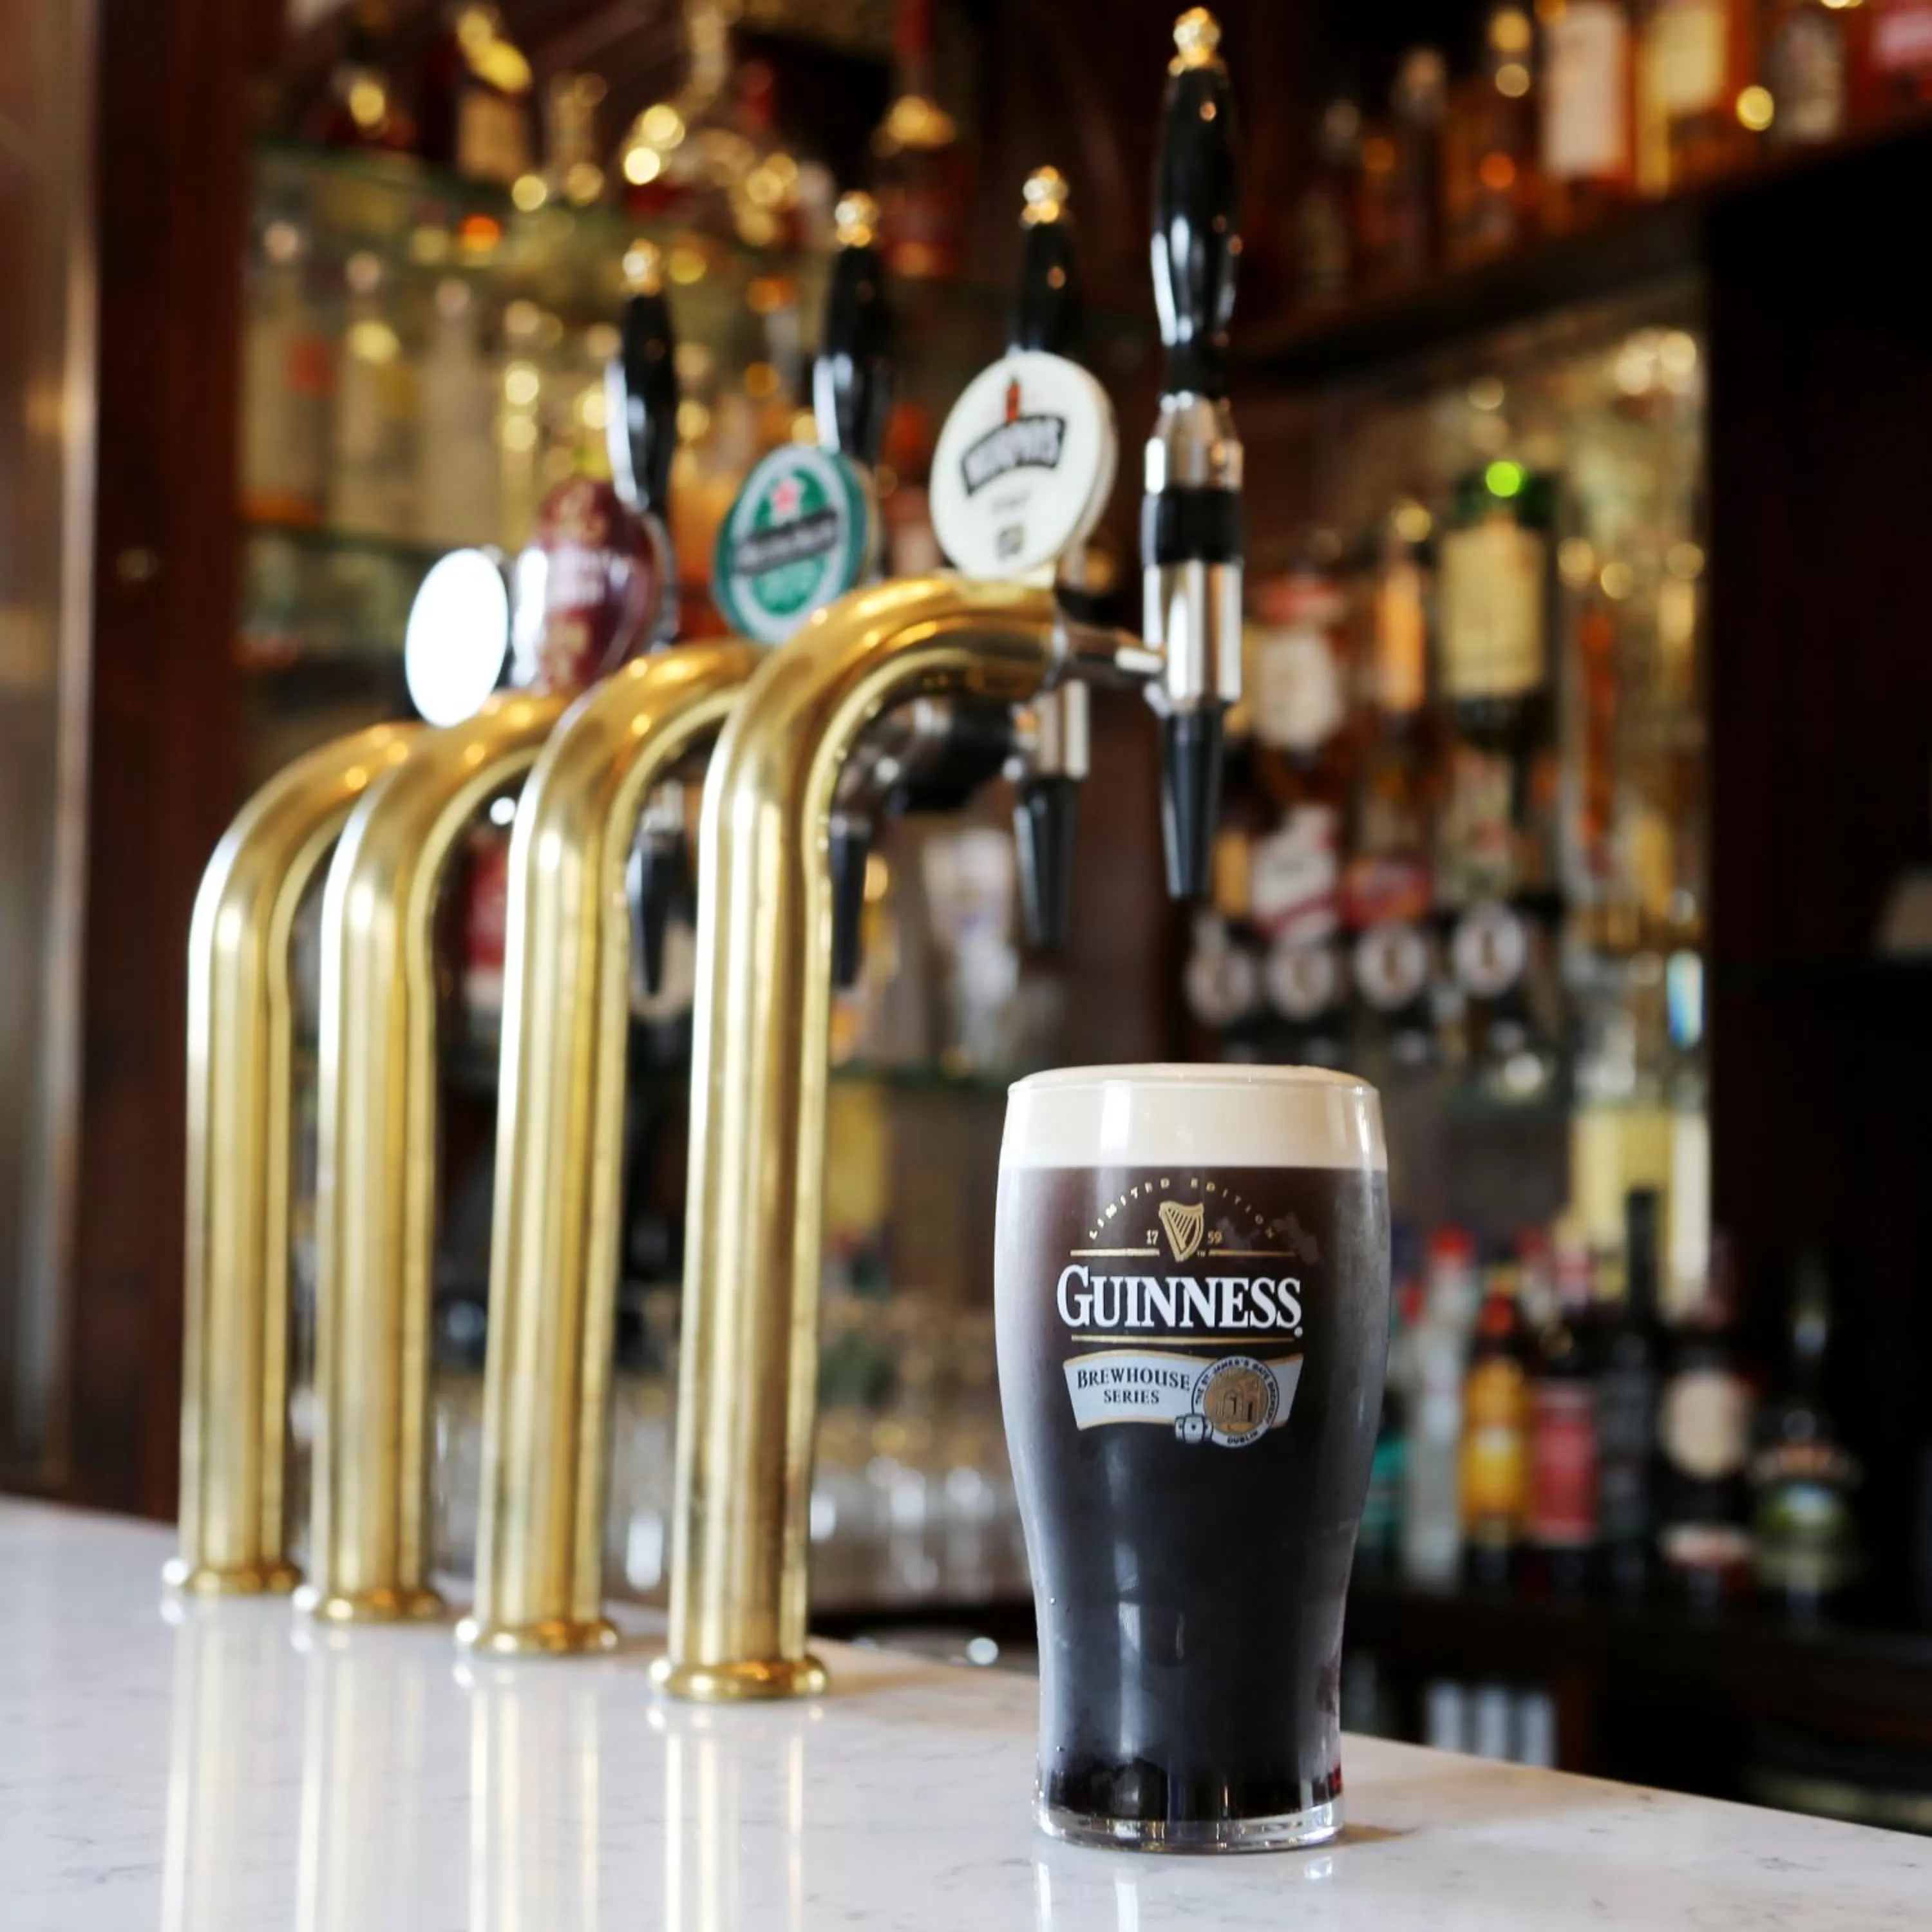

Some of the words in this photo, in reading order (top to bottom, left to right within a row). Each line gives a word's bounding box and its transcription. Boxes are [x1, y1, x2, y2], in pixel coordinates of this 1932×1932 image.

[1191, 1177, 1275, 1239] EDITION
[1146, 1229, 1159, 1245] 17
[1208, 1230, 1223, 1245] 59
[1057, 1264, 1302, 1328] GUINNESS
[1077, 1367, 1191, 1392] BREWHOUSE
[1103, 1388, 1160, 1405] SERIES
